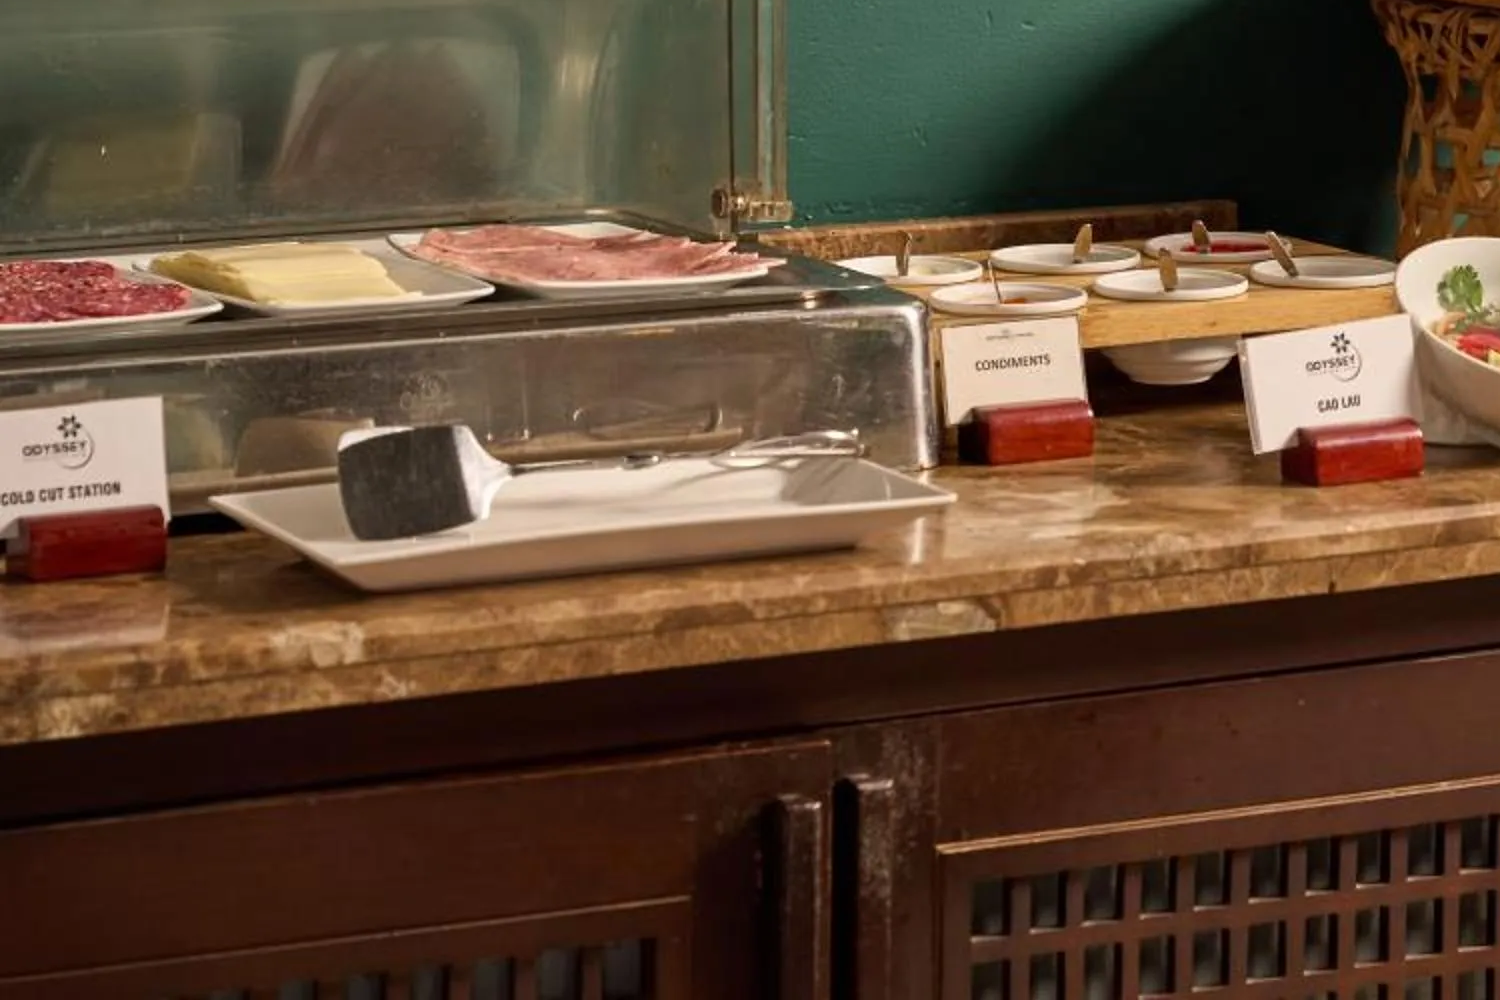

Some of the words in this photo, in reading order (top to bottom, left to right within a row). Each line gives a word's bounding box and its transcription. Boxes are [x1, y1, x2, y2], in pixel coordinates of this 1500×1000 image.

[975, 353, 1051, 371] CONDIMENTS
[1305, 353, 1355, 372] ODYSSEY
[1318, 396, 1339, 413] CAO
[22, 440, 86, 457] ODYSSEY
[1, 490, 35, 506] COLD
[39, 487, 64, 502] CUT
[68, 481, 121, 499] STATION
